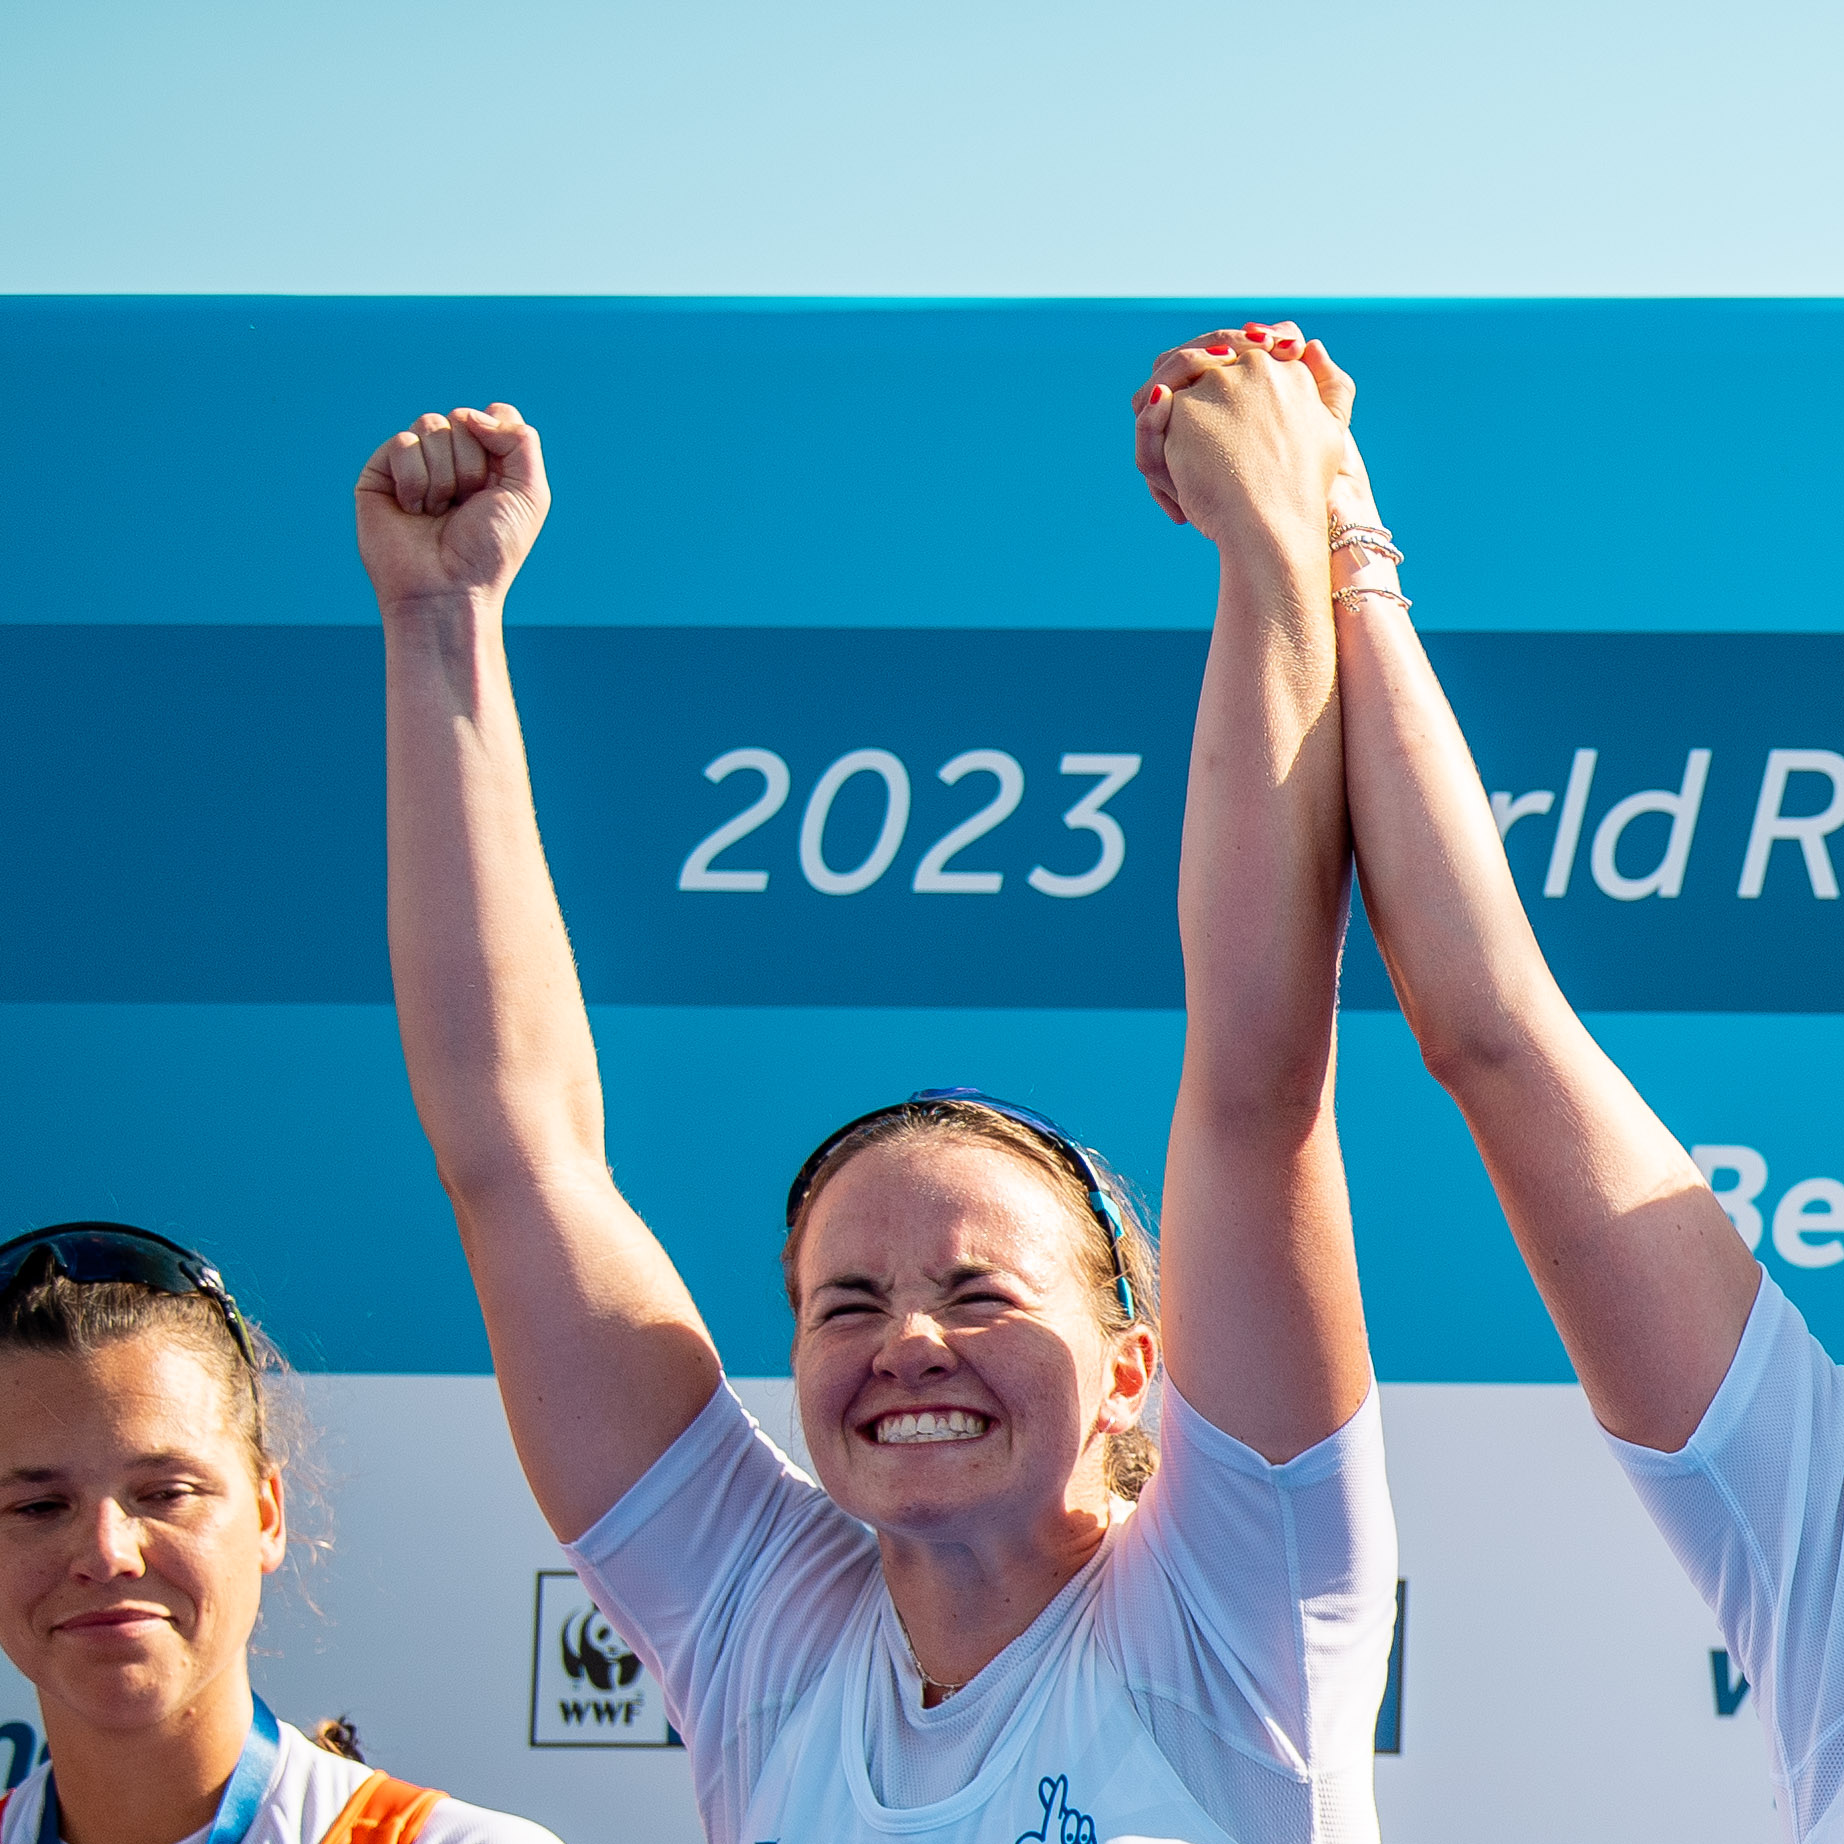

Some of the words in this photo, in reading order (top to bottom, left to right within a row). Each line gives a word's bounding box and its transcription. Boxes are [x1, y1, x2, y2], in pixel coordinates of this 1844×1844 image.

[677, 746, 1143, 899] 2023
[1489, 747, 1713, 902] rld
[558, 1698, 642, 1727] WWF
